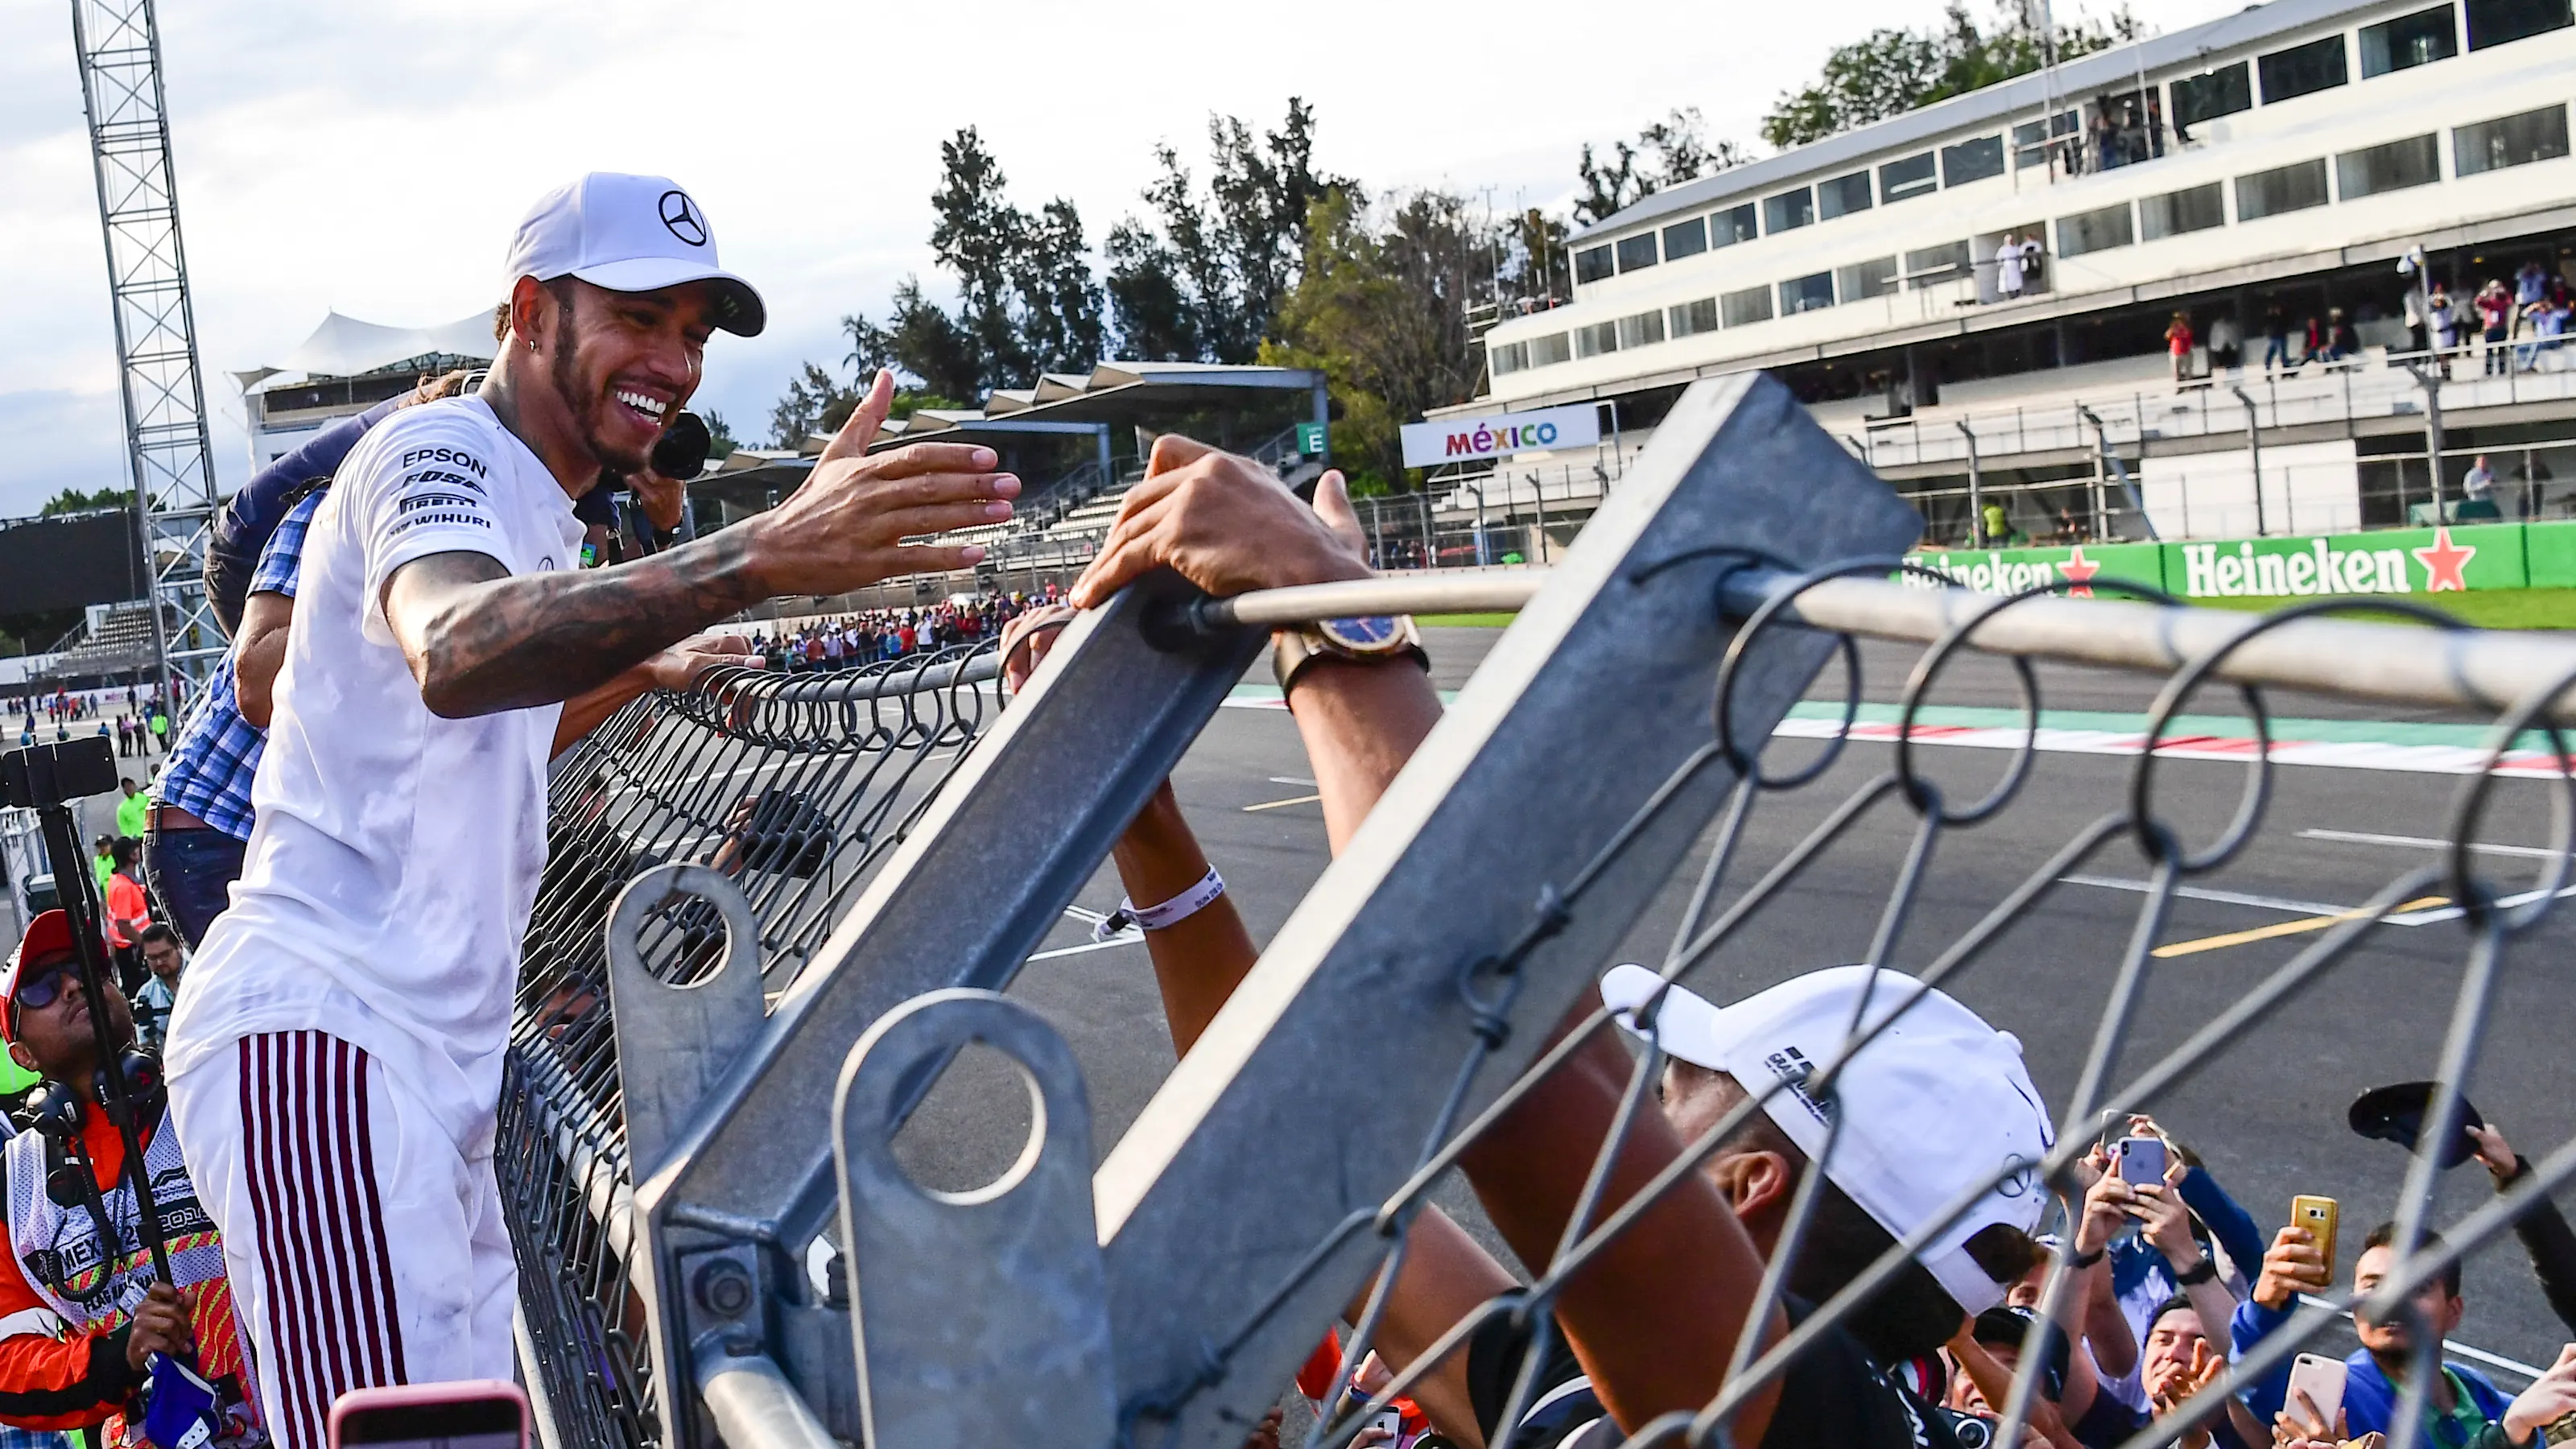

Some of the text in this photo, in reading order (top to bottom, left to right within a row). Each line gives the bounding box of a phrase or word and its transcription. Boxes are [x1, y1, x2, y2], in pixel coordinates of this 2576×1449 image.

[1309, 435, 1324, 452] E
[402, 448, 487, 480] EPSON
[415, 514, 491, 529] WIHURI
[2182, 537, 2412, 597] Heineken
[60, 1236, 104, 1271] MEX
